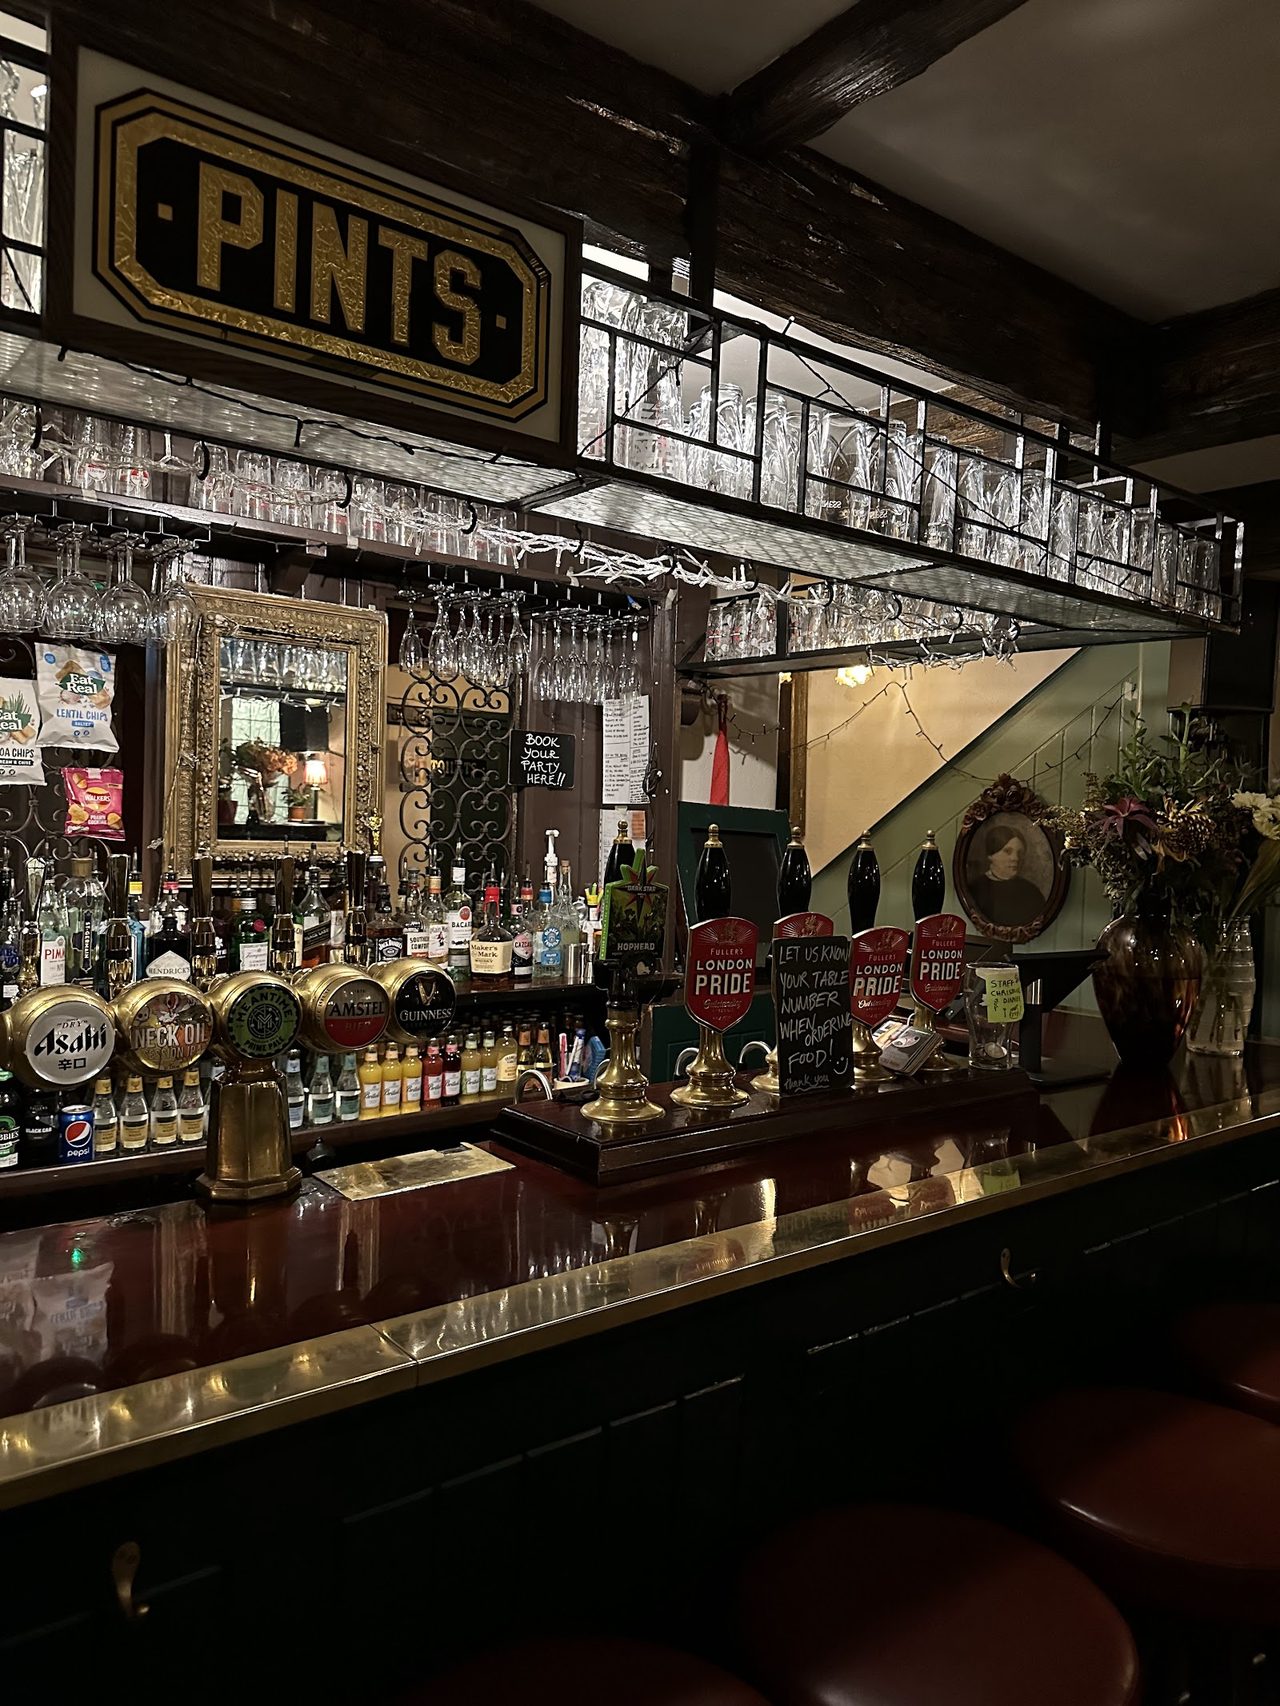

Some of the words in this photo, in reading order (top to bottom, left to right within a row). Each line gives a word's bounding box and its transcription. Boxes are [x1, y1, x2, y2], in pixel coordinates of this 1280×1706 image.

[197, 161, 481, 366] PINTS
[70, 674, 94, 685] Eat
[66, 682, 98, 694] Real
[56, 709, 84, 719] LENTIL
[86, 710, 108, 721] CHIPS
[0, 719, 22, 730] eal
[525, 733, 560, 748] BOOK
[12, 748, 34, 758] CHIPS
[520, 760, 560, 774] PARTY
[526, 772, 566, 787] HERE!!
[617, 942, 655, 951] HOPHEAD
[779, 945, 801, 964] LET
[805, 945, 819, 963] US
[921, 950, 964, 959] LONDON
[696, 958, 753, 971] LONDON
[856, 962, 904, 975] LONDON
[919, 961, 962, 981] PRIDE
[695, 972, 752, 996] PRIDE
[780, 971, 810, 997] YOUR
[812, 969, 849, 989] TABLE
[853, 975, 902, 997] PRIDE
[239, 991, 293, 1023] MEANTIME
[329, 1001, 385, 1017] AMSTEL
[781, 991, 841, 1014] NUMBER
[400, 1008, 453, 1022] GUINNESS
[780, 1013, 817, 1042] WHEN
[805, 1011, 851, 1047] ORDERING
[34, 1022, 107, 1057] Asahi
[133, 1025, 179, 1049] NECK
[184, 1023, 208, 1045] OIL
[58, 1057, 87, 1070] 辛口
[67, 1146, 91, 1158] pepsi
